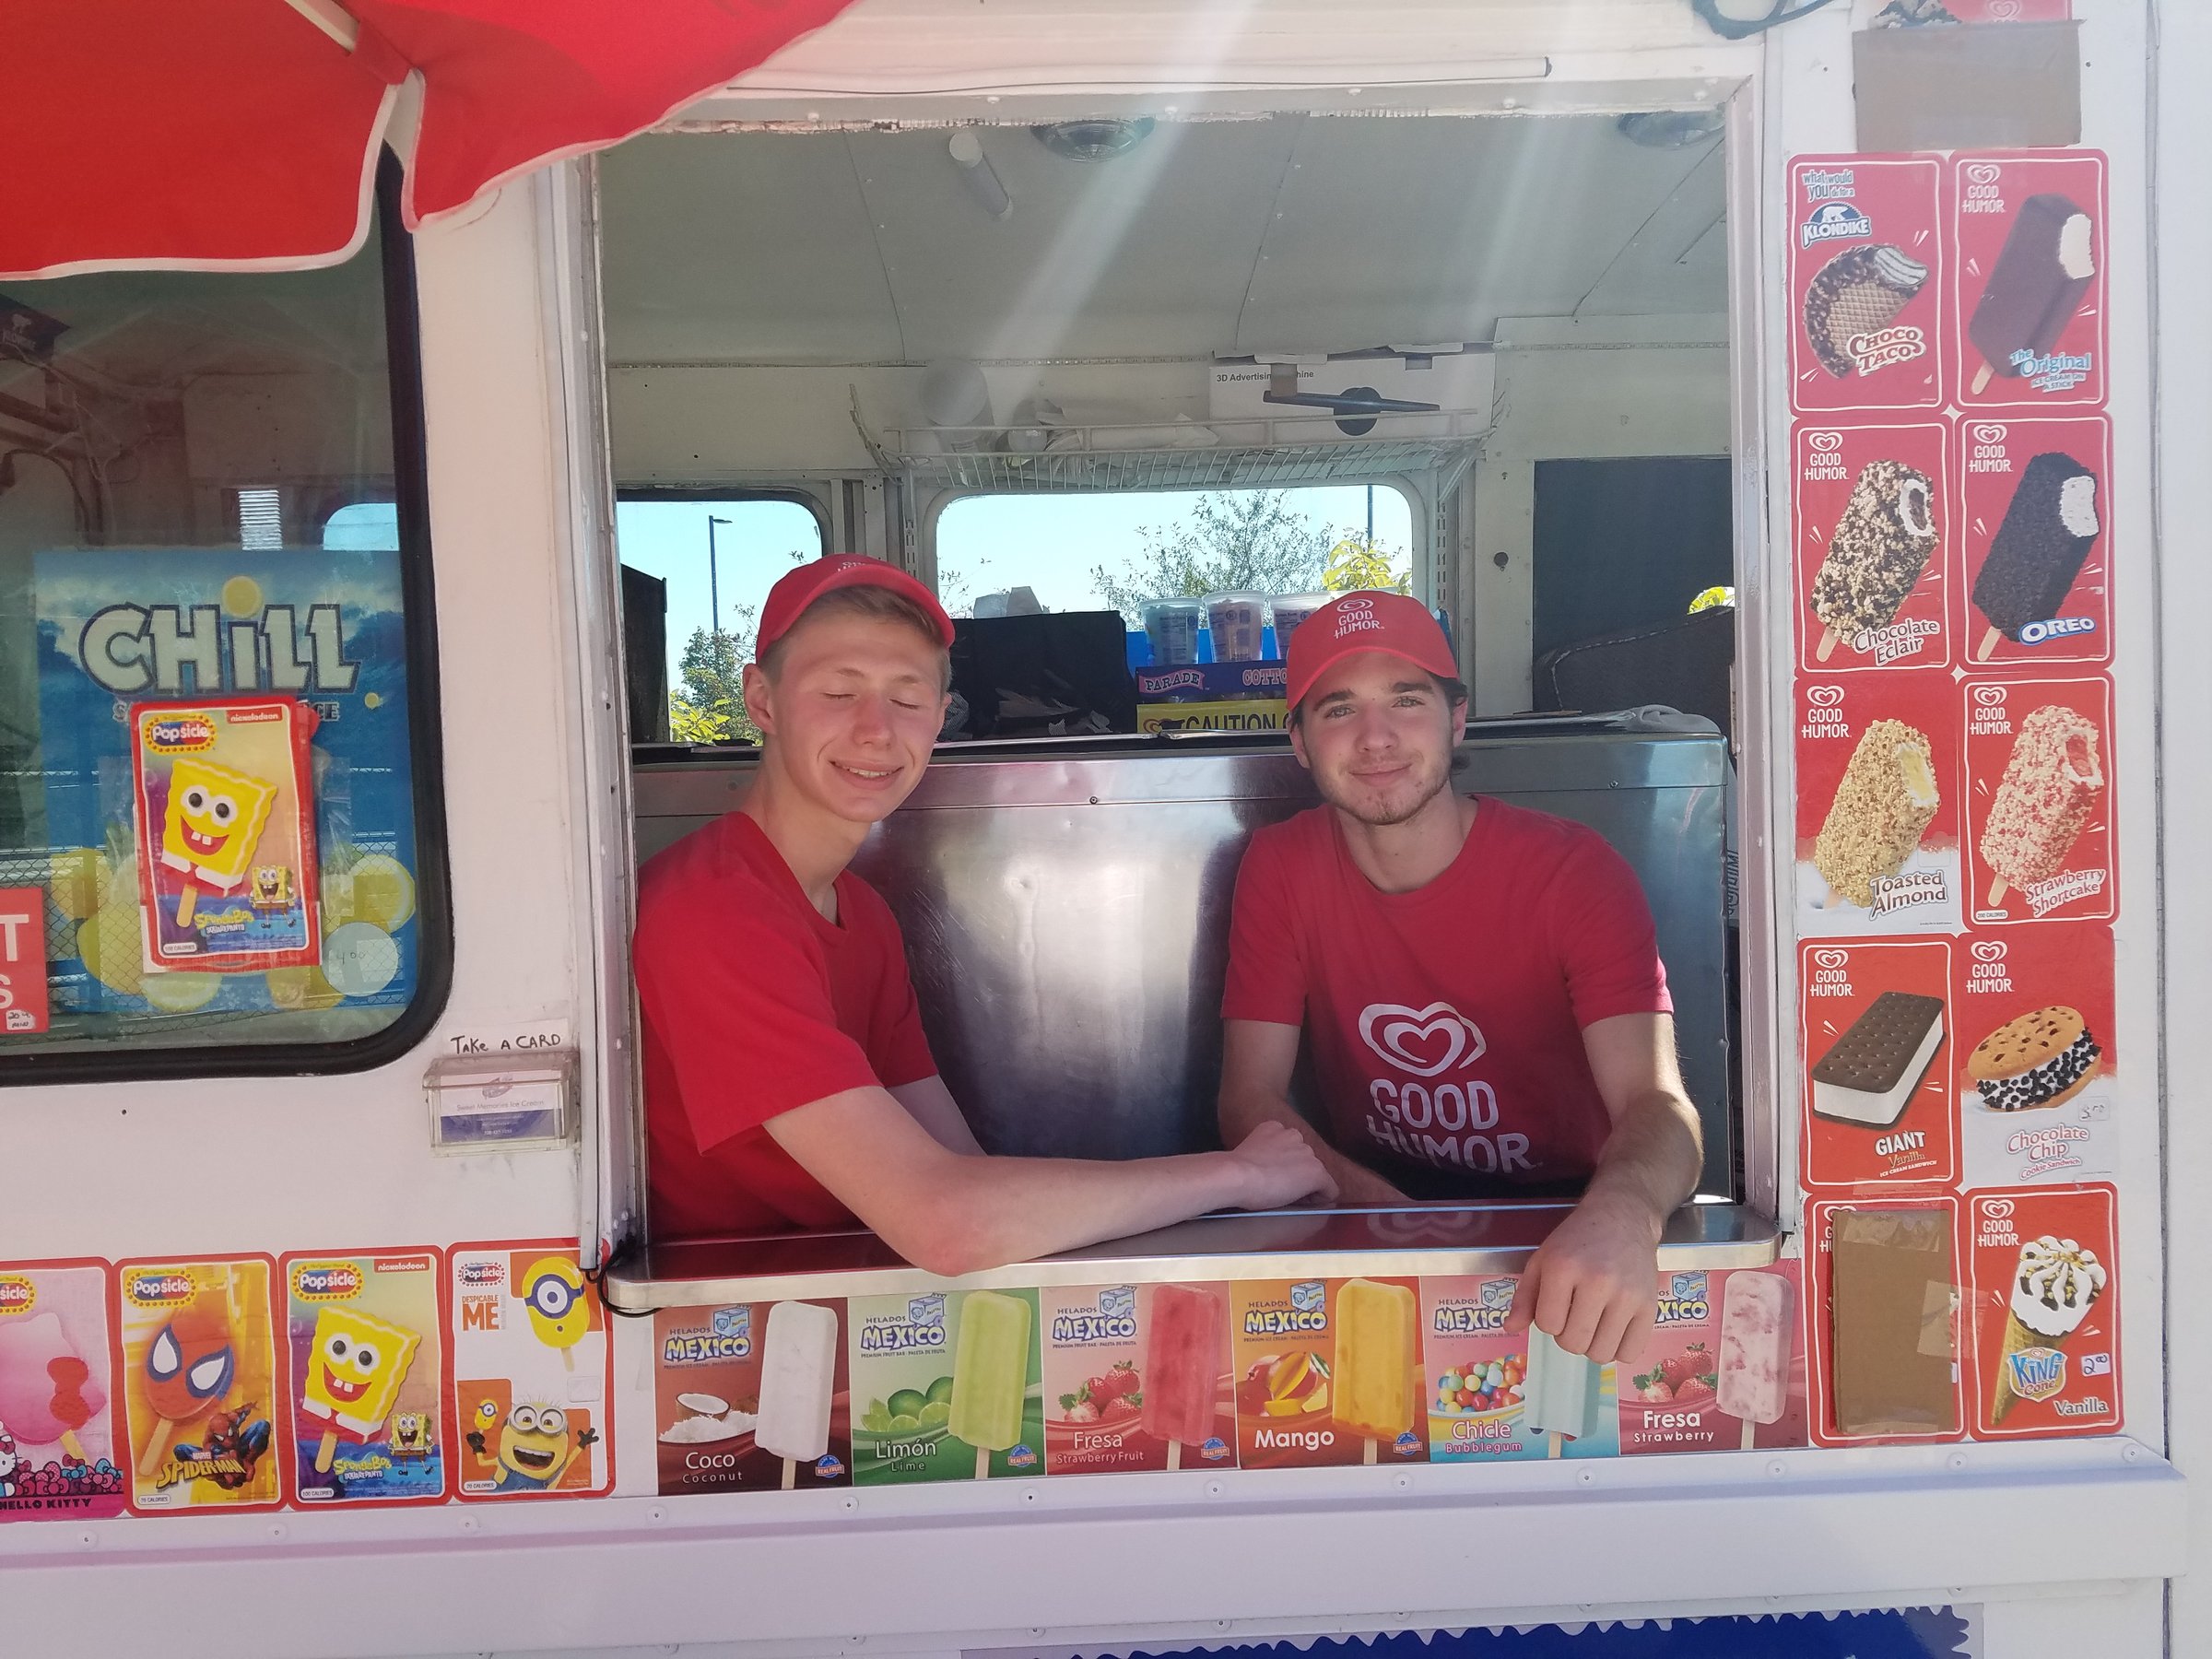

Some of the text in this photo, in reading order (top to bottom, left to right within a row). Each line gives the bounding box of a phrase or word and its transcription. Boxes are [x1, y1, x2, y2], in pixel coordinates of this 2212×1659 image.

[1968, 185, 1999, 199] GOOD
[1962, 199, 2006, 213] HUMOR
[1802, 218, 1870, 247] KLONDIKE
[1849, 328, 1920, 358] CHOCO
[1858, 346, 1912, 371] TACO
[2011, 349, 2032, 363] The
[2020, 353, 2090, 375] Original
[1230, 372, 1271, 382] Advertisin
[1809, 453, 1841, 466] GOOD
[1974, 445, 2006, 459] GOOD
[1805, 467, 1848, 480] HUMOR
[1969, 459, 2012, 473] HUMOR
[1338, 610, 1372, 626] GOOD
[1334, 620, 1381, 639] HUMOR
[1854, 618, 1938, 653] Chocolate
[2020, 618, 2095, 643] OREO
[1876, 638, 1922, 665] Eclair
[1145, 668, 1287, 690] PARADE COTTO
[230, 712, 278, 723] nickelodeon
[1186, 713, 1276, 729] CAUTION
[1808, 708, 1842, 724] GOOD
[1975, 708, 2006, 721] GOOD
[151, 720, 208, 742] Popsicle
[1802, 724, 1850, 738] HUMOR
[1970, 721, 2011, 735] HUMOR
[1873, 872, 1942, 896] Toasted
[2027, 869, 2105, 900] Strawberry
[1871, 887, 1946, 918] Almond
[2033, 883, 2099, 916] Shortcake
[1815, 970, 1847, 983] GOOD
[1971, 963, 2006, 979] GOOD
[1810, 983, 1853, 997] HUMOR
[1966, 979, 2013, 994] HUMOR
[516, 1033, 561, 1049] CARD
[1370, 1078, 1500, 1131] GOOD
[1366, 1114, 1535, 1173] HUMOR
[1875, 1130, 1925, 1156] GIANT
[2007, 1124, 2088, 1152] Chocolate
[2030, 1141, 2066, 1160] Chip
[1888, 1151, 1925, 1169] Vanilla
[1889, 1165, 1908, 1174] CREAM
[1908, 1159, 1937, 1170] SANDWICH
[2020, 1159, 2080, 1179] Cookie Sandwich
[1983, 1220, 2014, 1233] GOOD
[1977, 1233, 2018, 1247] HUMOR
[378, 1263, 426, 1272] nickelodeon
[464, 1267, 501, 1280] Popsicle
[134, 1278, 190, 1297] Popsicle
[300, 1272, 357, 1290] Popsicle
[462, 1295, 499, 1303] DESPICABLE
[463, 1302, 500, 1331] ME
[1654, 1300, 1709, 1324] XICO
[1053, 1315, 1136, 1341] MEXICO
[1243, 1310, 1327, 1335] MEXICO
[861, 1325, 946, 1351] MEXICO
[665, 1336, 751, 1362] MEXICO
[2024, 1380, 2056, 1395] Cone
[2054, 1398, 2108, 1415] Vanilla
[1643, 1410, 1700, 1429] Fresa
[1452, 1419, 1512, 1441] Chicle
[1633, 1430, 1714, 1443] Strawberry
[876, 1439, 936, 1458] Limón
[1073, 1431, 1123, 1449] Fresa
[1254, 1429, 1335, 1451] Mango
[1445, 1441, 1523, 1454] Bubblegum
[686, 1452, 735, 1469] Coco
[891, 1461, 925, 1472] Lime
[1056, 1451, 1144, 1465] Strawberry Fruit
[156, 1459, 247, 1489] SPIDER-MAN
[682, 1471, 743, 1483] Coconut
[46, 1498, 91, 1509] KITTY
